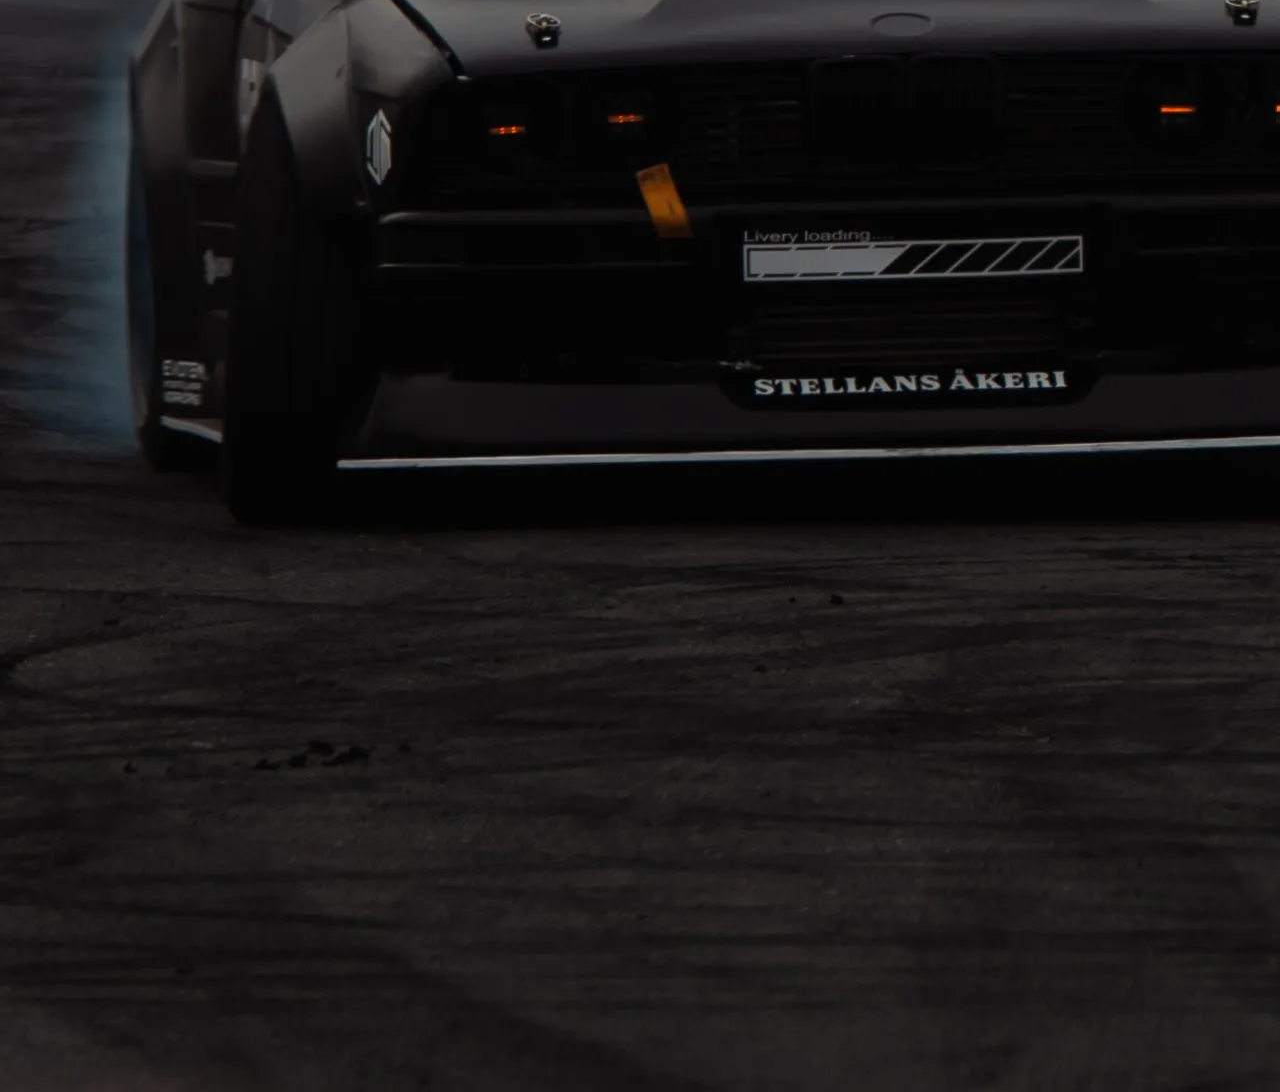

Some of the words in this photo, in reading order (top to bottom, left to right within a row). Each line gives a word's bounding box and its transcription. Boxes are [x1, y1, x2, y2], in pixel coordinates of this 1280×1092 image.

[743, 229, 799, 243] Livery
[755, 373, 941, 395] STELLANS
[950, 368, 1068, 390] ÅKERI
